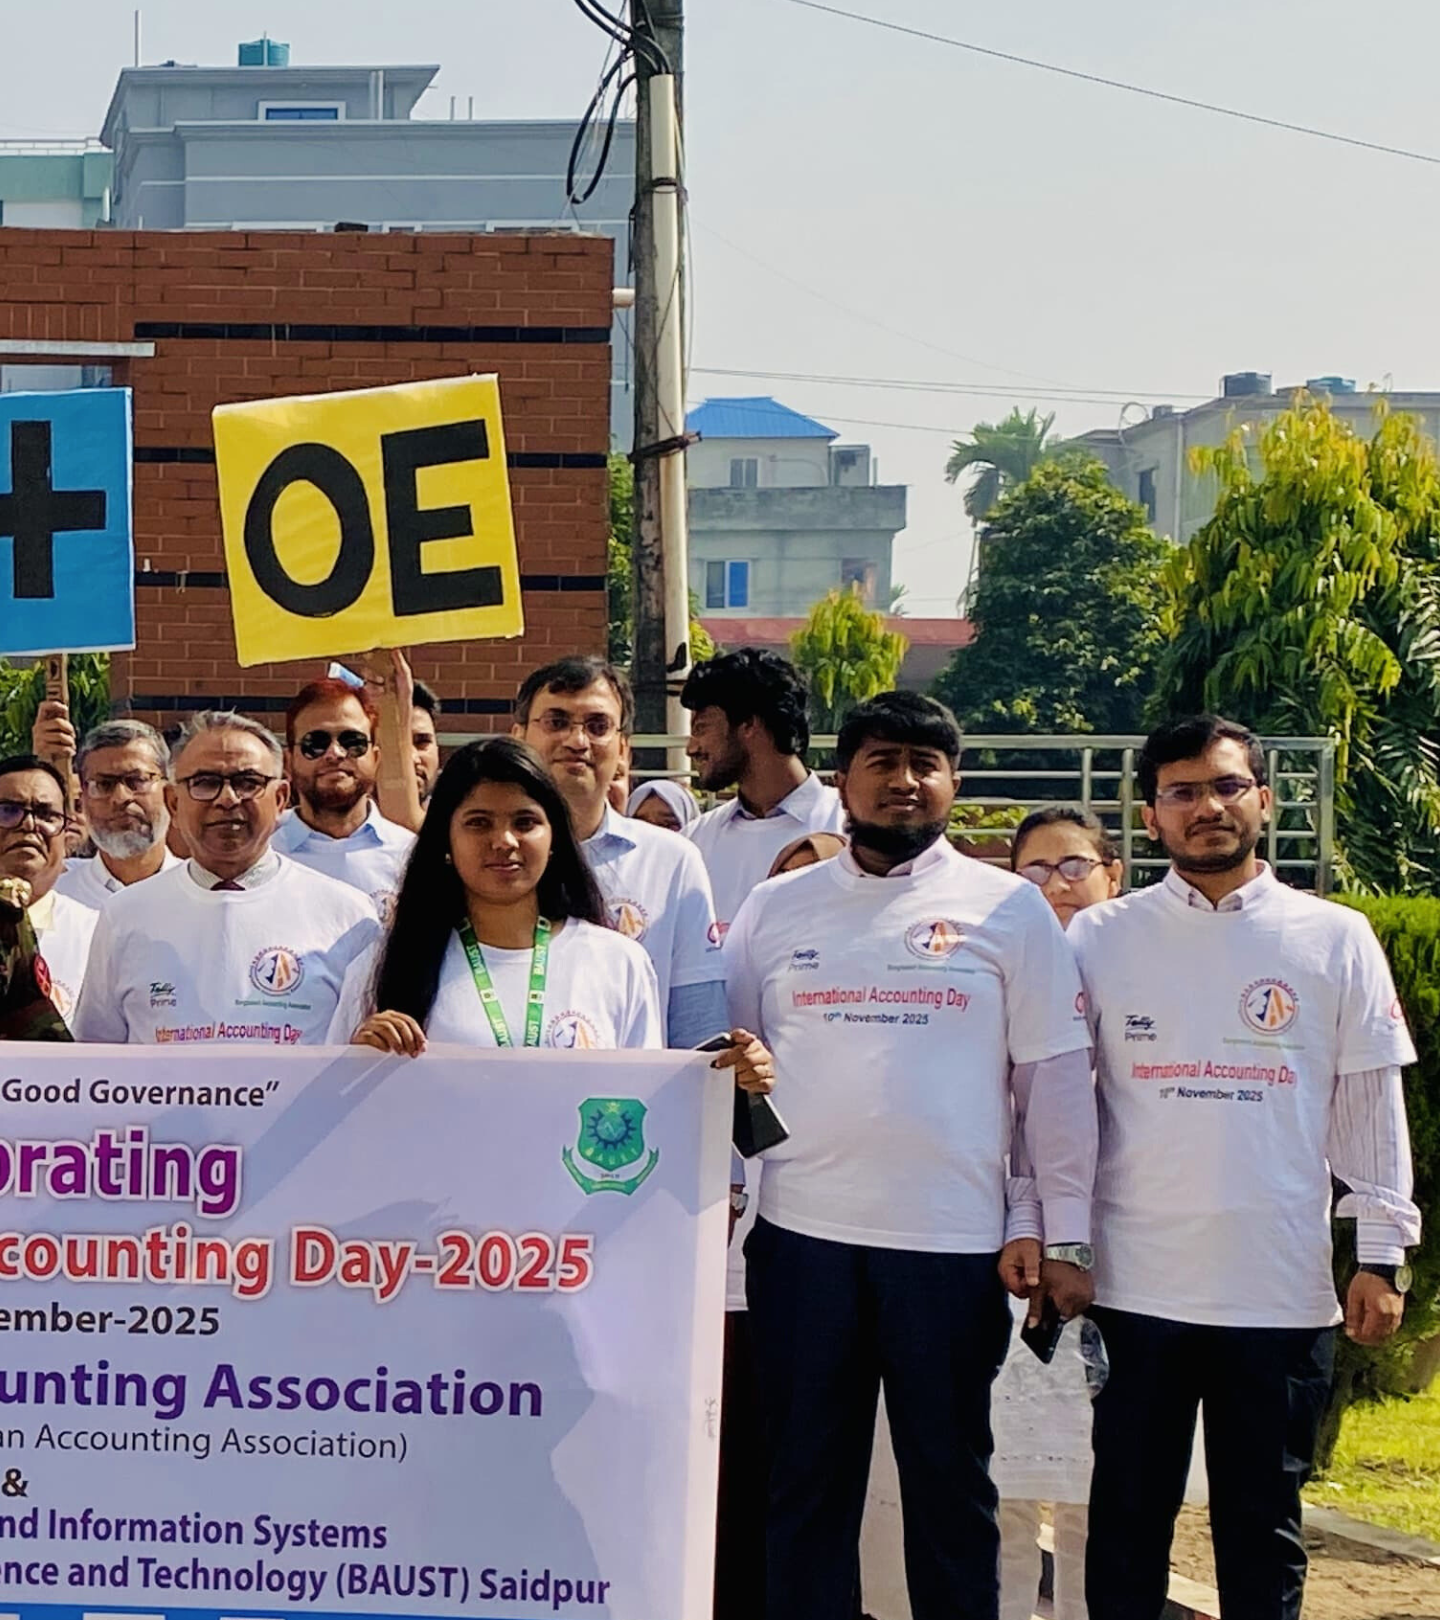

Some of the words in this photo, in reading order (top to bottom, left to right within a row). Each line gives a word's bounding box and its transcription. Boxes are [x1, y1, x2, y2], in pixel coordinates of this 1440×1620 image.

[243, 418, 504, 619] OE
[533, 944, 547, 975] BAUST
[792, 986, 867, 1007] International
[869, 986, 942, 1010] Accounting
[946, 987, 971, 1012] Day
[155, 1021, 216, 1043] International
[217, 1021, 281, 1044] Accounting
[284, 1024, 303, 1045] Day
[492, 1018, 511, 1047] AUST
[525, 1019, 540, 1047] AUST
[844, 1012, 900, 1024] November
[902, 1013, 929, 1025] 2025
[1124, 1031, 1157, 1042] Prime
[1131, 1060, 1201, 1080] International
[1203, 1060, 1275, 1086] Accounting
[1, 1078, 81, 1104] Good
[89, 1080, 281, 1107] Governance”
[1177, 1087, 1235, 1101] November
[1237, 1089, 1264, 1102] 2025
[292, 1229, 593, 1299] Day-2025
[203, 1363, 543, 1417] Association
[35, 1424, 211, 1460] Accounting
[220, 1427, 408, 1463] Association)
[1, 1468, 28, 1498] &
[49, 1509, 243, 1546] Information
[253, 1515, 388, 1554] Systems
[68, 1556, 129, 1587] and
[138, 1557, 328, 1600] Technology
[336, 1564, 470, 1604] (BAUST)
[479, 1568, 610, 1611] Saidpur
